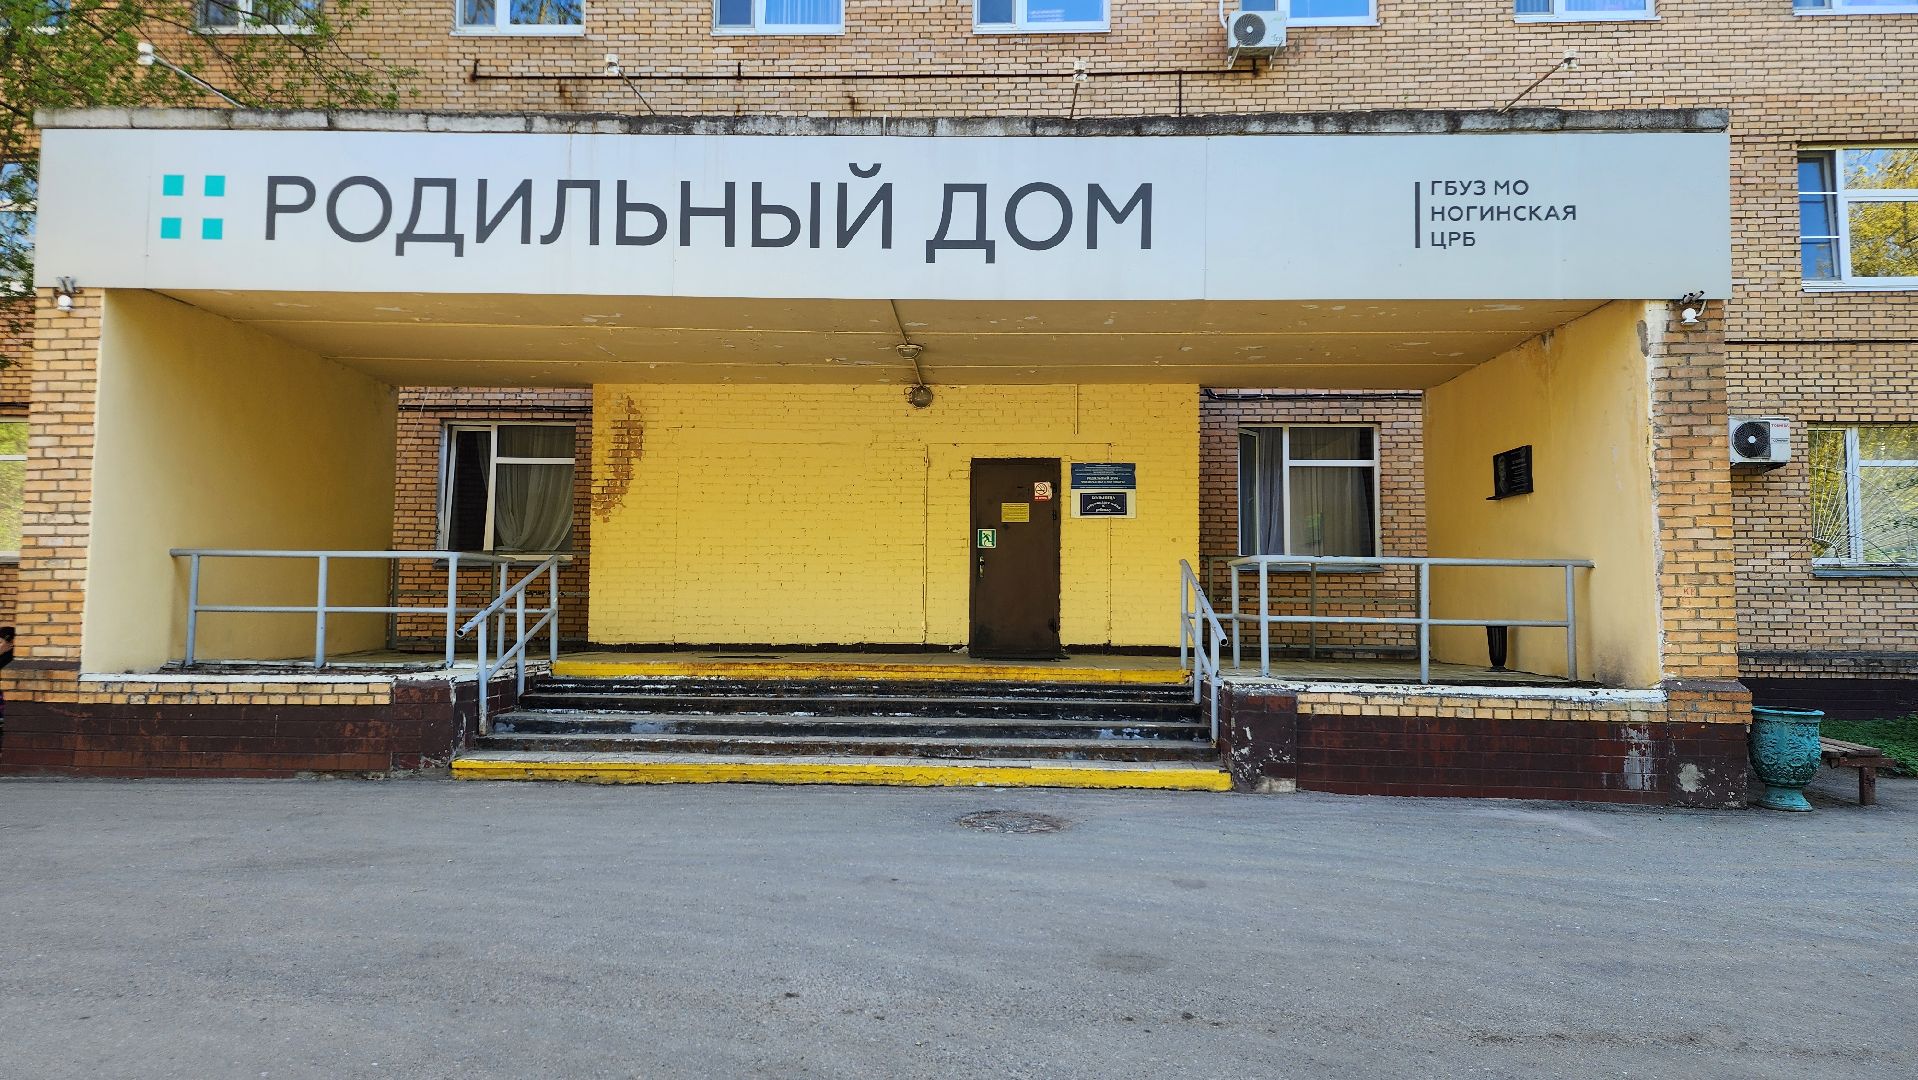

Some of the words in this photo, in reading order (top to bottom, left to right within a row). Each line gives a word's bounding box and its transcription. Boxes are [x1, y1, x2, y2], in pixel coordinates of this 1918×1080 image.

[1431, 180, 1486, 196] ГБУЗ
[1494, 179, 1530, 196] МО
[265, 162, 893, 258] РОДИЛЬНЫЙ
[925, 181, 1153, 264] ДОМ
[1431, 205, 1577, 222] НОГИНСКАЯ
[1431, 231, 1476, 250] ЦРБ
